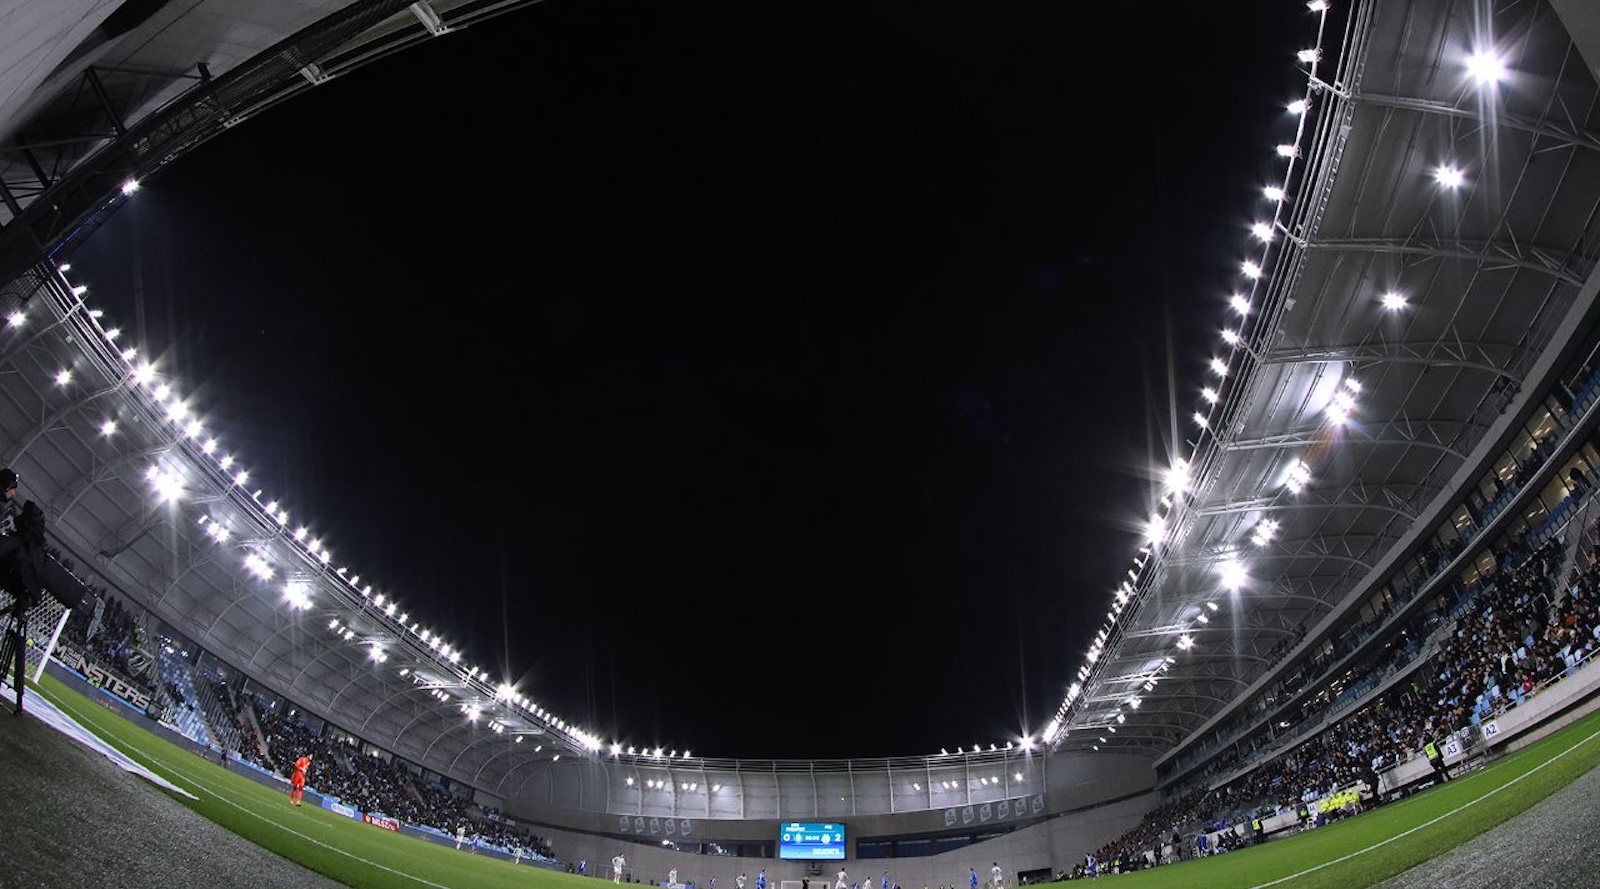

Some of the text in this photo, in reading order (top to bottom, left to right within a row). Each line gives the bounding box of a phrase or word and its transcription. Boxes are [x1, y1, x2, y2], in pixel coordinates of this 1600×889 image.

[1485, 724, 1497, 736] A2
[1447, 744, 1457, 756] A3
[783, 833, 791, 841] 0
[834, 833, 841, 841] 2
